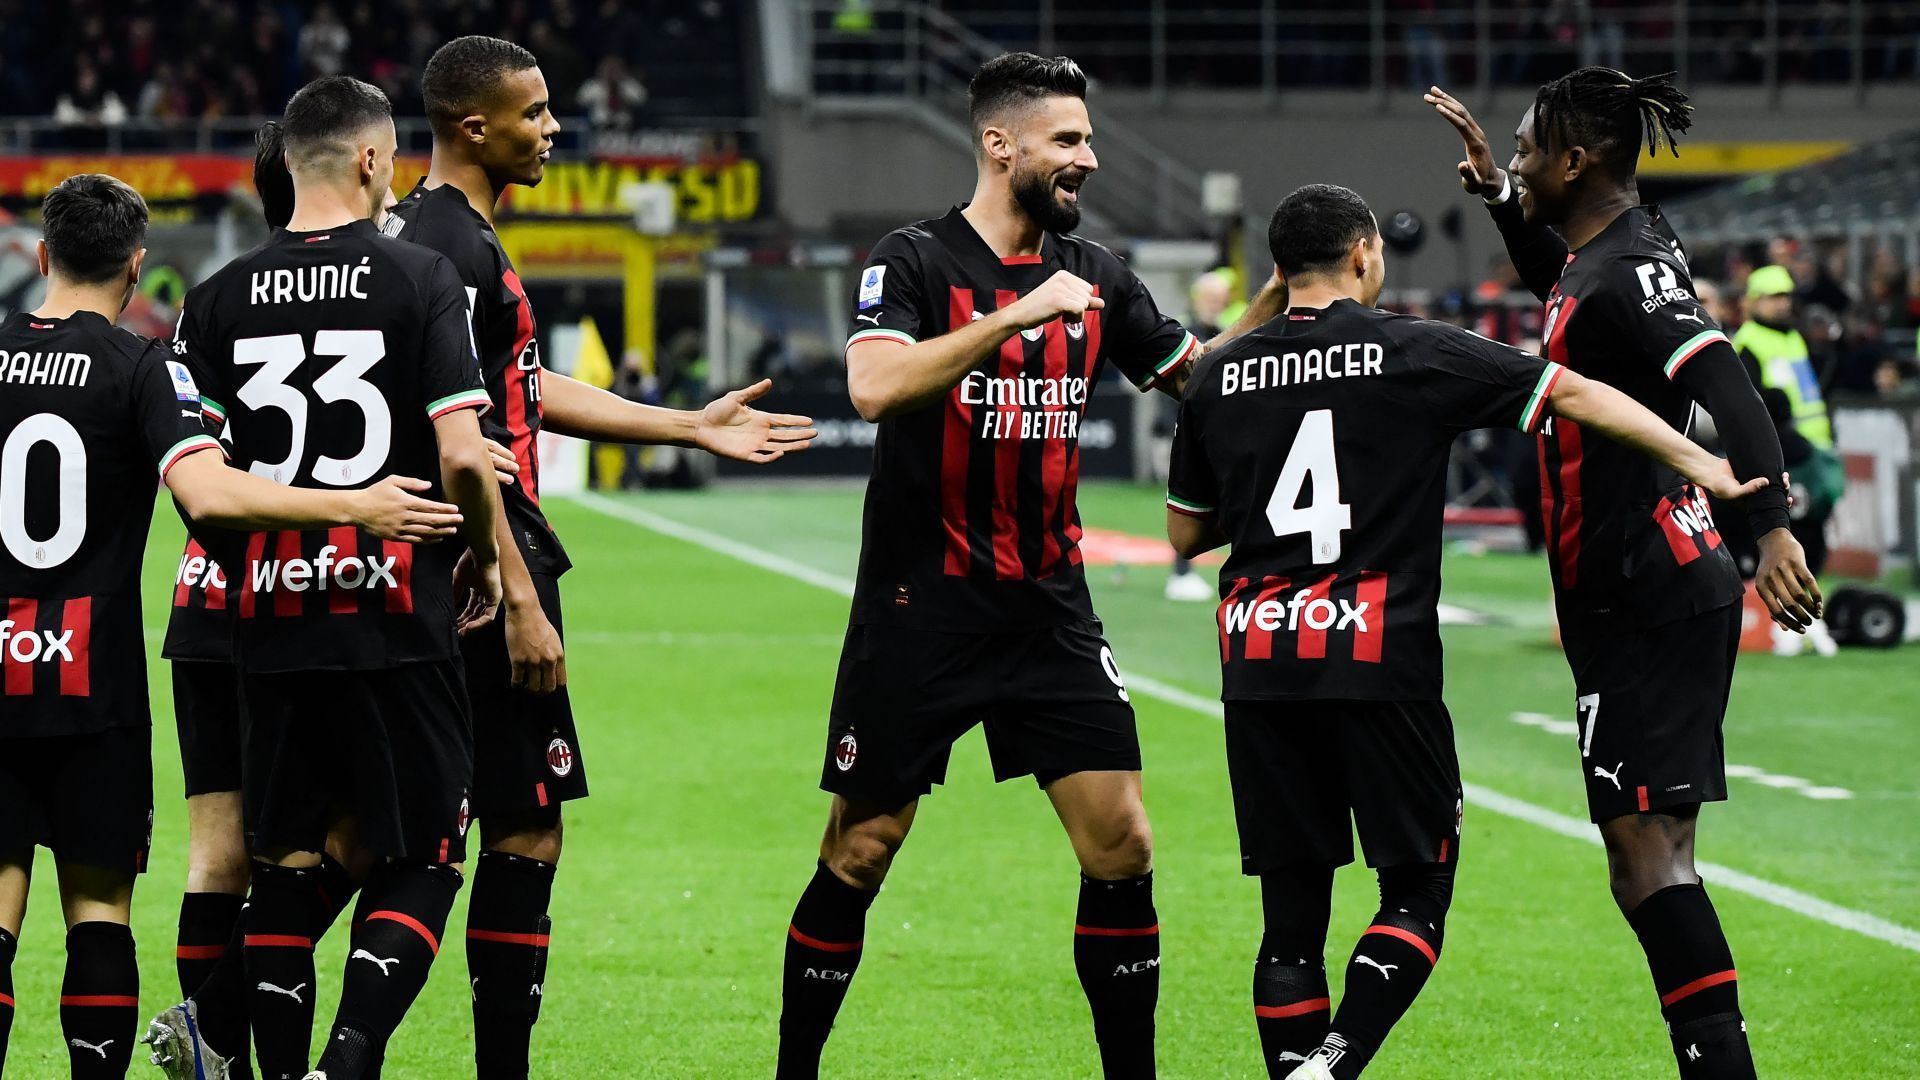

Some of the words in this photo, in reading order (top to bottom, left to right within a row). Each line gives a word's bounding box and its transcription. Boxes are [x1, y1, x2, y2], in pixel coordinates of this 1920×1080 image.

[250, 256, 371, 305] KRUNIĆ
[960, 370, 1089, 406] Emirates
[1222, 342, 1384, 396] BENNACER
[233, 330, 392, 486] 33
[981, 411, 1016, 439] FLY
[1020, 410, 1078, 439] BETTER
[0, 412, 87, 569] 0
[1265, 409, 1352, 564] 4
[252, 545, 398, 593] wefox
[1225, 588, 1370, 635] wefox
[1100, 646, 1130, 702] 9
[1579, 693, 1600, 757] 7
